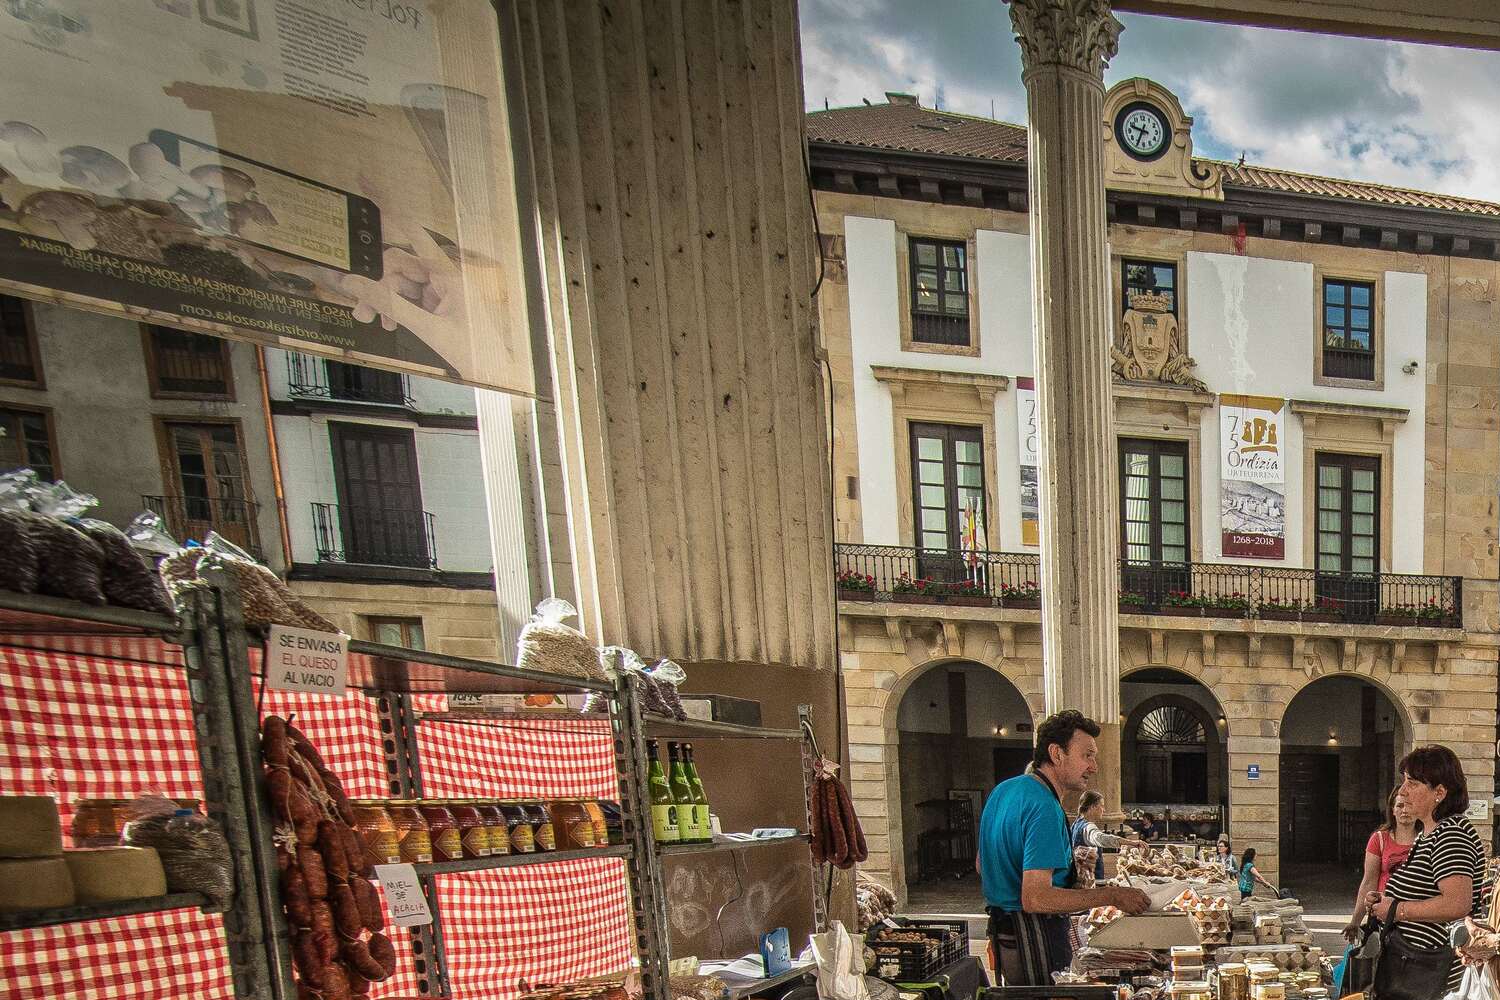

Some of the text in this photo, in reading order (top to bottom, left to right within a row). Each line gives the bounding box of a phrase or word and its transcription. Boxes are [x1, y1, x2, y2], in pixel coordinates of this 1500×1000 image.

[1227, 415, 1239, 433] 7
[1230, 433, 1239, 449] 5
[1227, 450, 1279, 471] Ordizia
[1232, 535, 1275, 546] 1268-2018
[280, 634, 342, 654] SE ENVASA
[282, 652, 338, 671] EL QUESO
[283, 671, 335, 687] AL VACIO
[386, 880, 412, 890] MIEL
[393, 903, 425, 915] ACACIA
